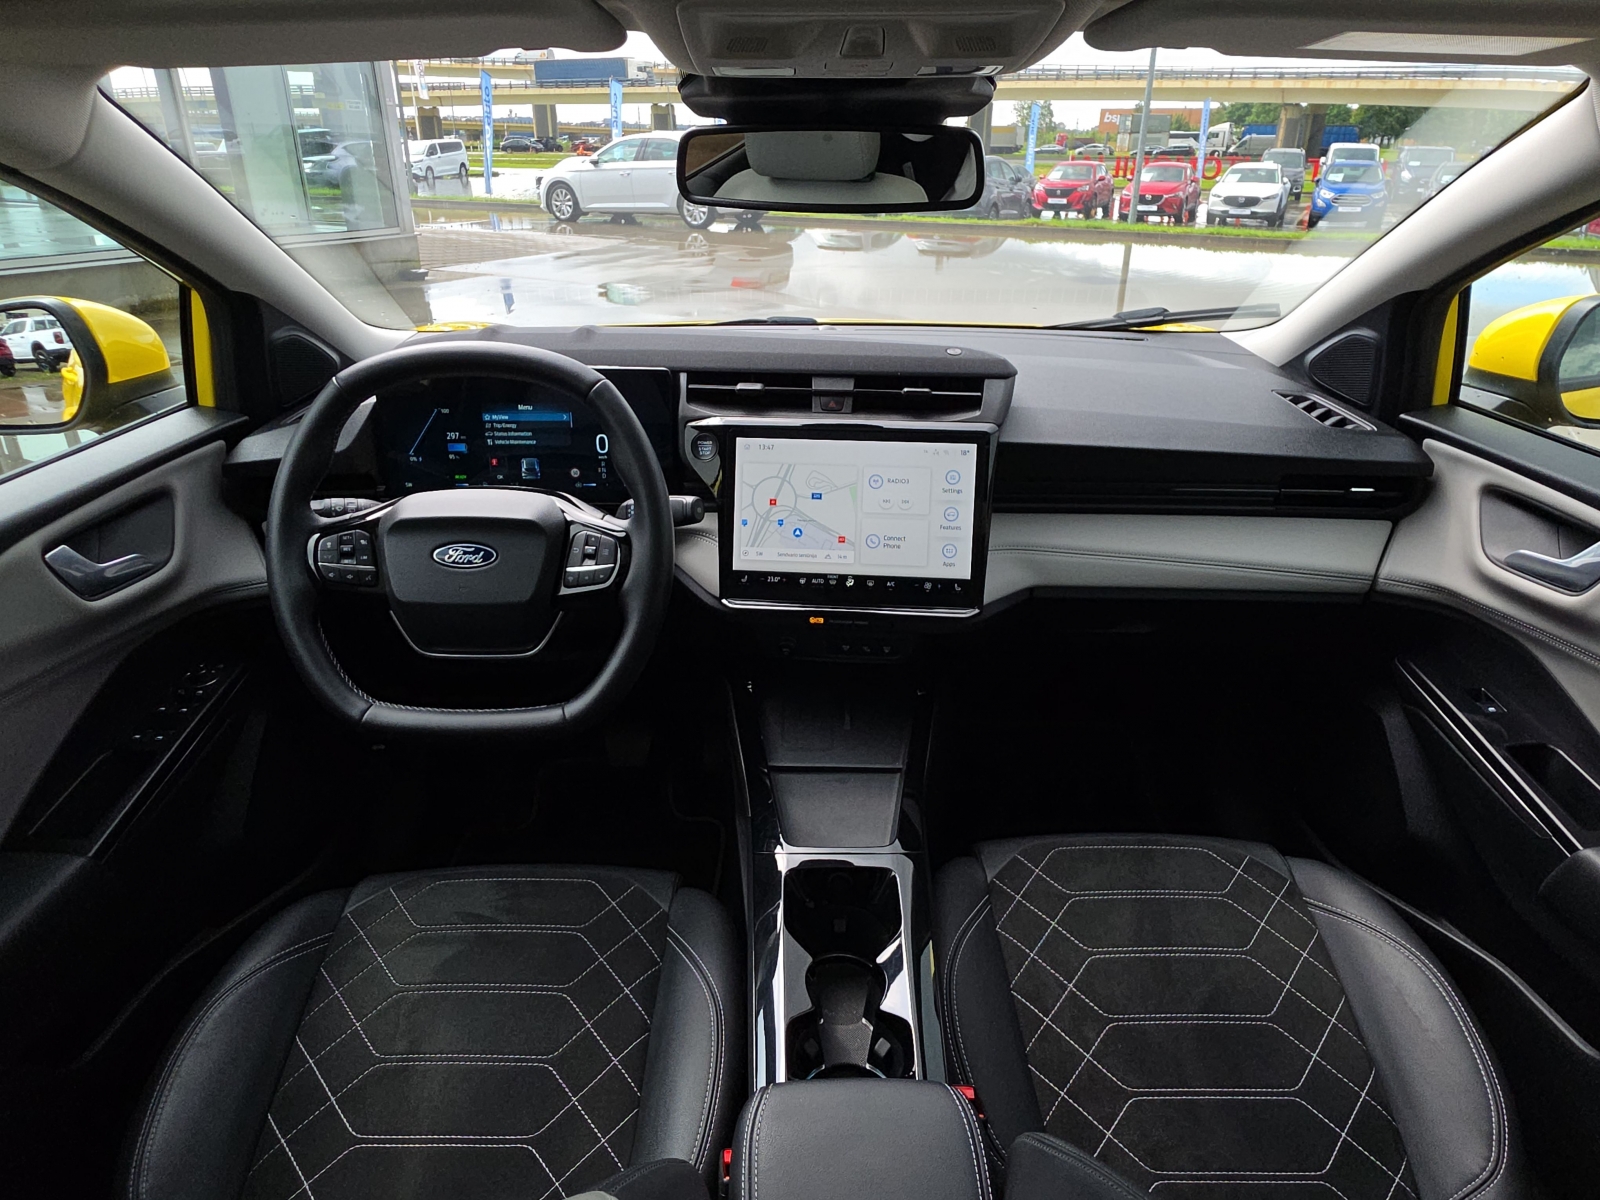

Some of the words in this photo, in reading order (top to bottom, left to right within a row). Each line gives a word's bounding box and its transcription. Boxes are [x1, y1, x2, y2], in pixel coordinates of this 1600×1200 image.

[446, 432, 460, 440] 297
[595, 434, 609, 454] 0
[445, 547, 483, 563] Ford
